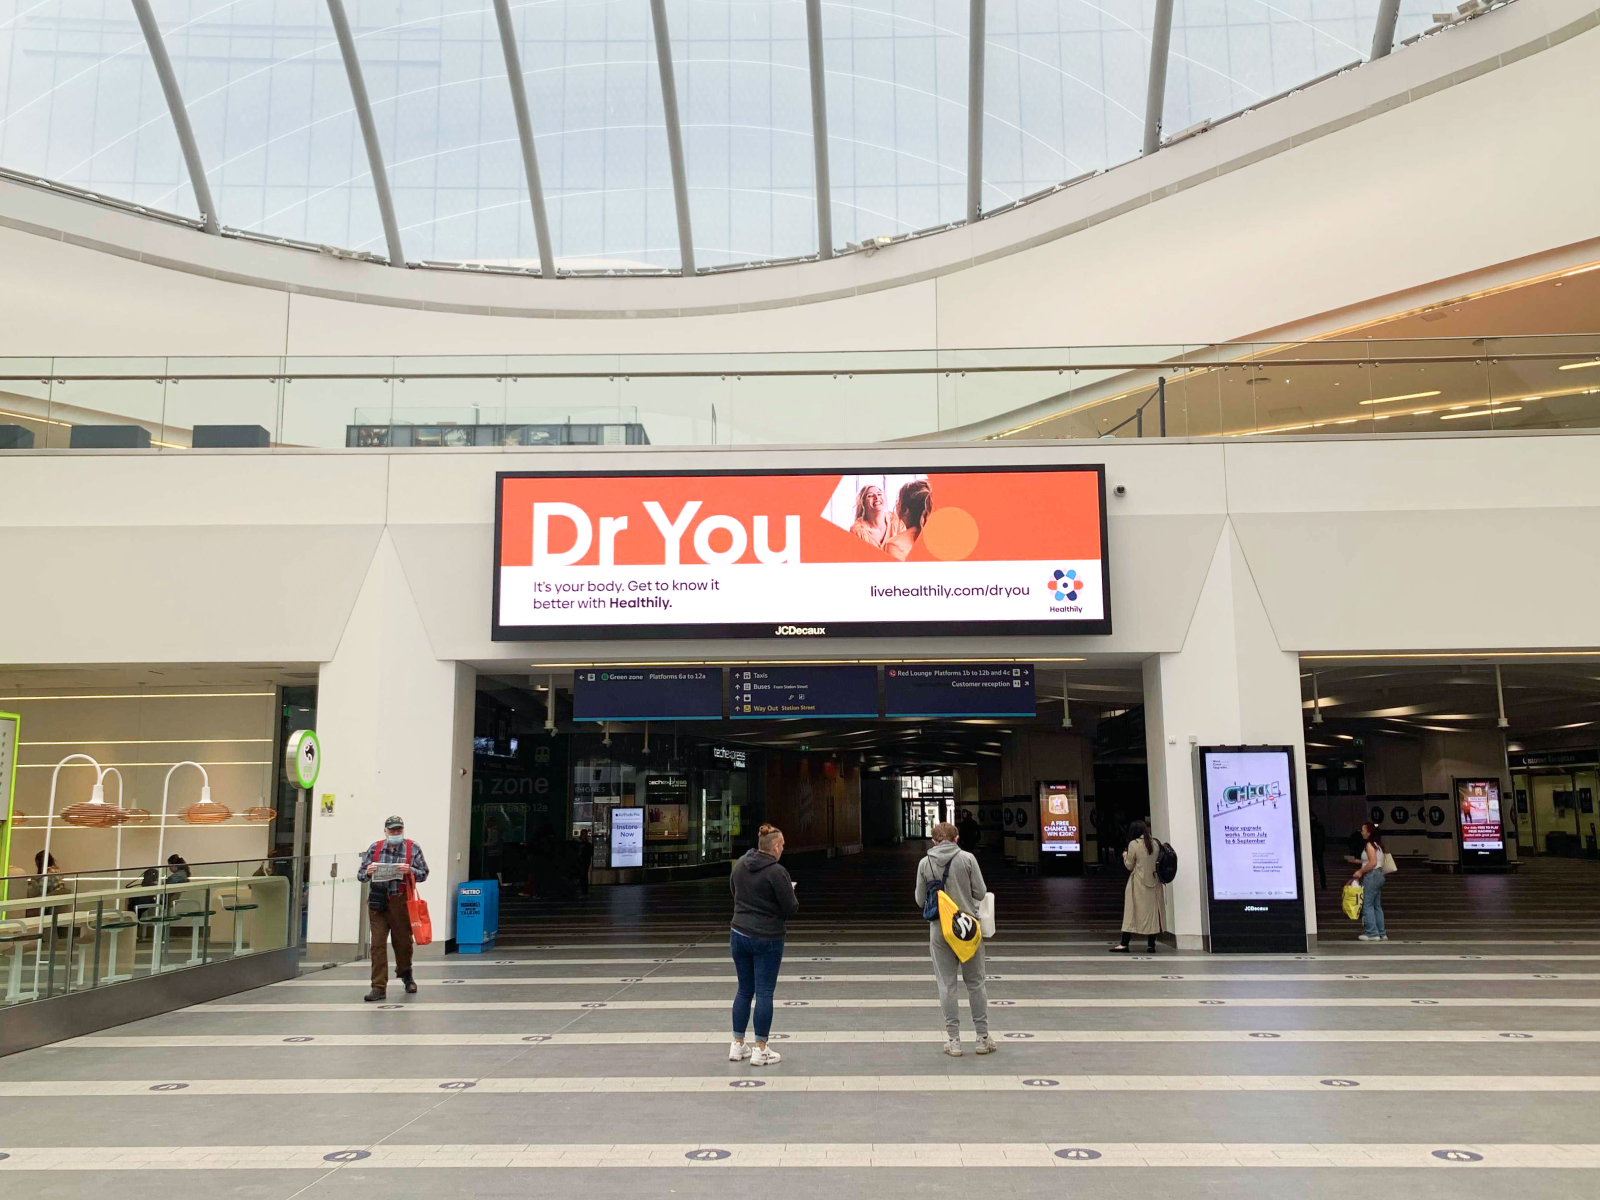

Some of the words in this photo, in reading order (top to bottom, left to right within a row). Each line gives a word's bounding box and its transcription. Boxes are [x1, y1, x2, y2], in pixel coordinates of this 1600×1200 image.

[532, 501, 628, 567] Dr
[642, 500, 801, 566] You
[554, 582, 585, 595] your
[587, 580, 625, 594] body.
[627, 580, 653, 592] Get
[655, 580, 669, 592] to
[672, 579, 708, 591] know
[710, 578, 720, 591] it
[870, 584, 1030, 599] livehealthily.com/dryou
[533, 598, 576, 610] better
[577, 596, 606, 609] with
[609, 595, 673, 611] Healthily.
[775, 625, 826, 636] JCDecaux
[694, 672, 706, 680] 12a
[910, 670, 932, 678] Lounge
[934, 669, 962, 677] Platforms
[951, 680, 981, 688] Customer
[981, 680, 1011, 689] reception
[753, 705, 766, 713] Way
[491, 777, 549, 795] zone
[1240, 824, 1262, 832] upgrade
[1236, 837, 1266, 845] September
